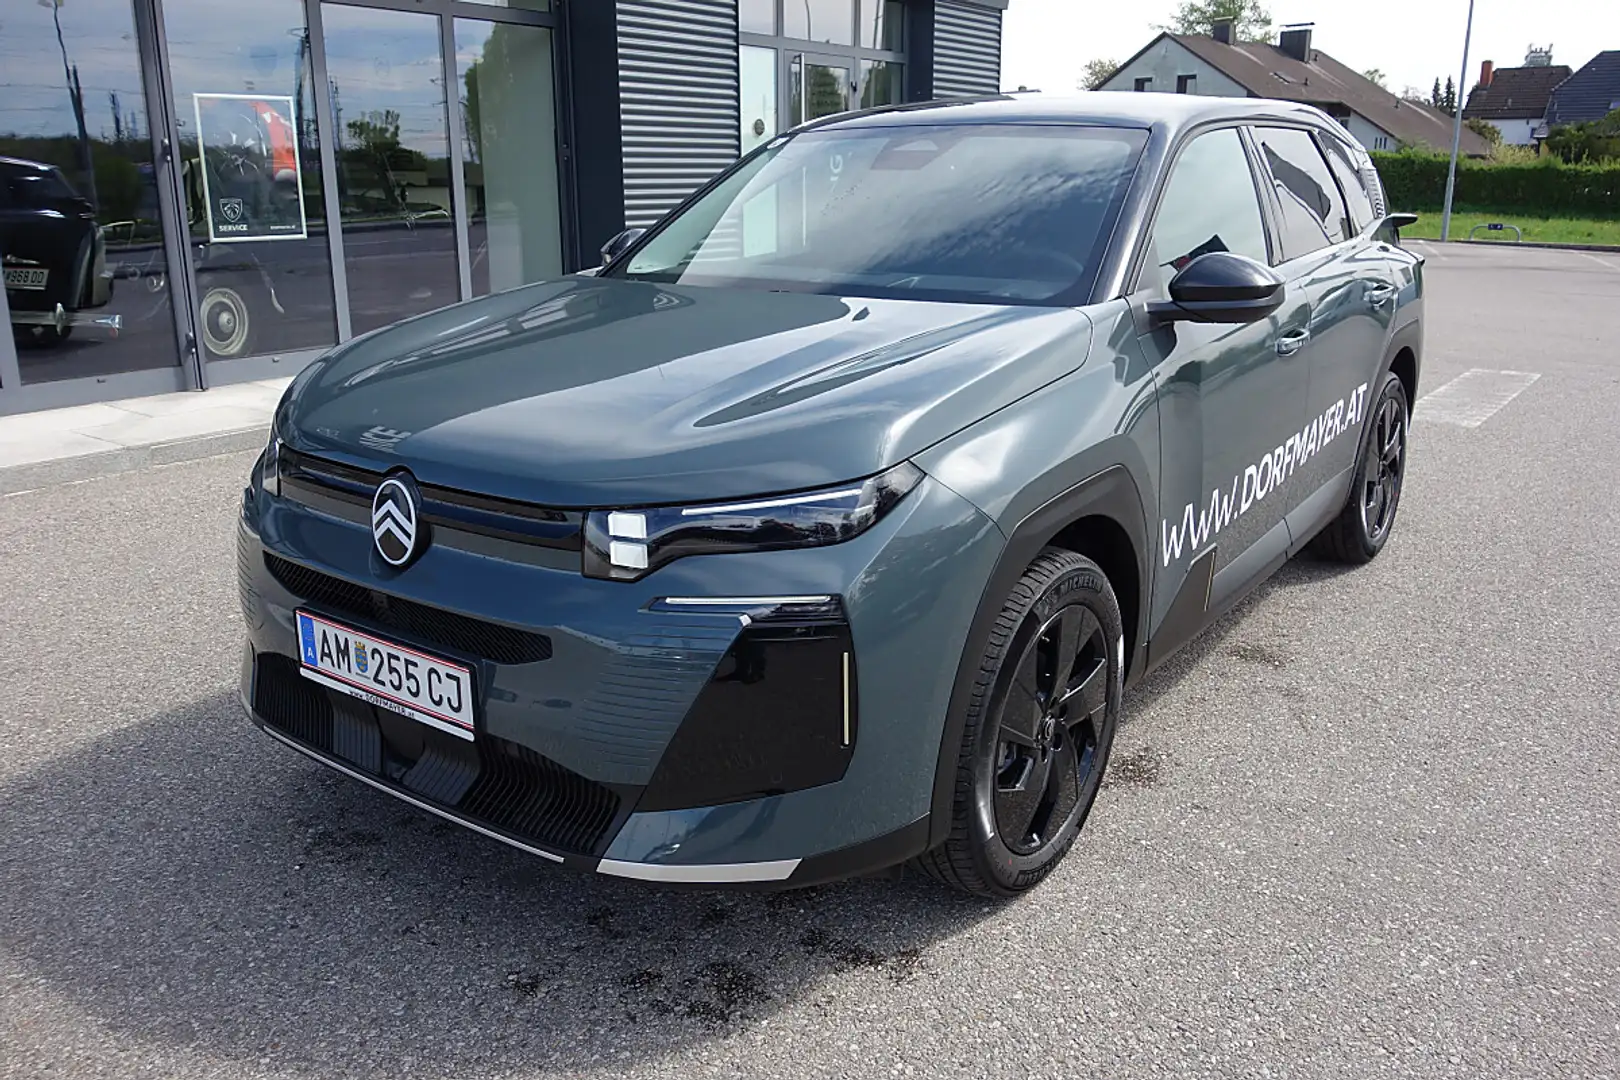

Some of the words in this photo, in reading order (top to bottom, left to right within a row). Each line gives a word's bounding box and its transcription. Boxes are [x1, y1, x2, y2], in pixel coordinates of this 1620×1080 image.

[218, 224, 248, 232] SERVICE
[10, 270, 30, 283] 968
[1162, 382, 1368, 567] WWW.DORFMAYER.AT
[307, 647, 315, 659] A
[320, 629, 352, 673] AM
[371, 647, 421, 698] 255
[427, 667, 463, 713] CJ
